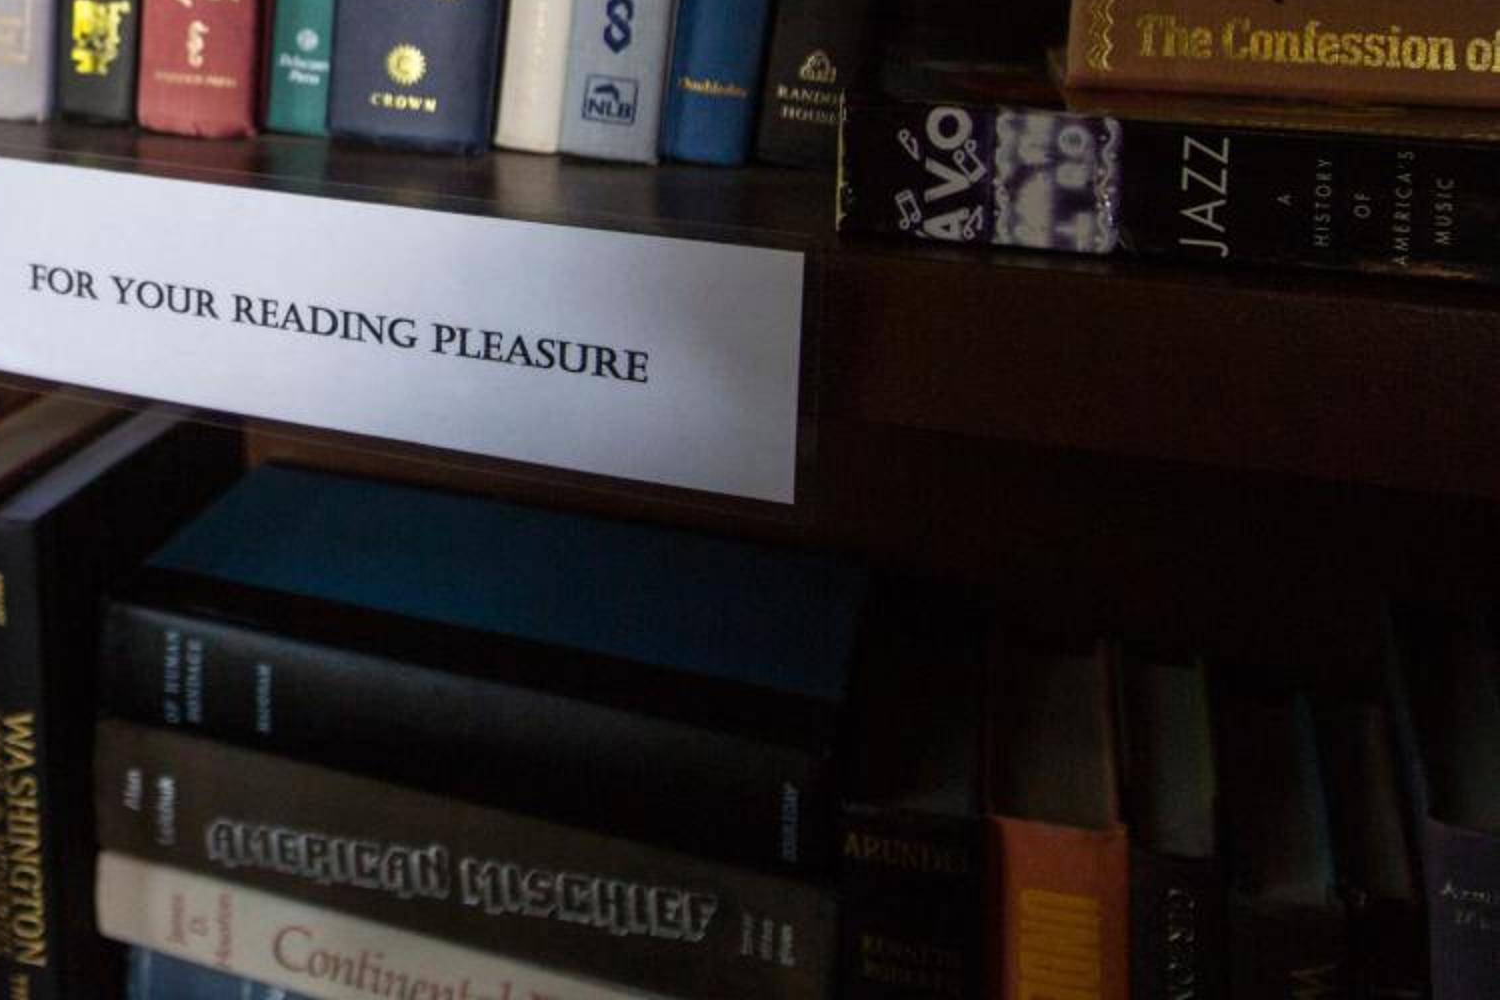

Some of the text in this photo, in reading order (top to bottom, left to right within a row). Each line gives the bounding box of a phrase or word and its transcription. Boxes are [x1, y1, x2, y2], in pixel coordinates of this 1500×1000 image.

[1135, 13, 1213, 58] The
[1220, 16, 1458, 73] Confession
[369, 92, 437, 113] CROWN
[1177, 135, 1231, 259] JAZZ
[1274, 193, 1292, 207] A
[1312, 157, 1334, 248] HISTORY
[1351, 192, 1373, 219] OF
[1431, 176, 1455, 247] MUSIC
[28, 263, 649, 384] FOR YOUR READING PLEASURE
[3, 710, 47, 970] WASHINGTON
[206, 816, 452, 900] AMERICAN
